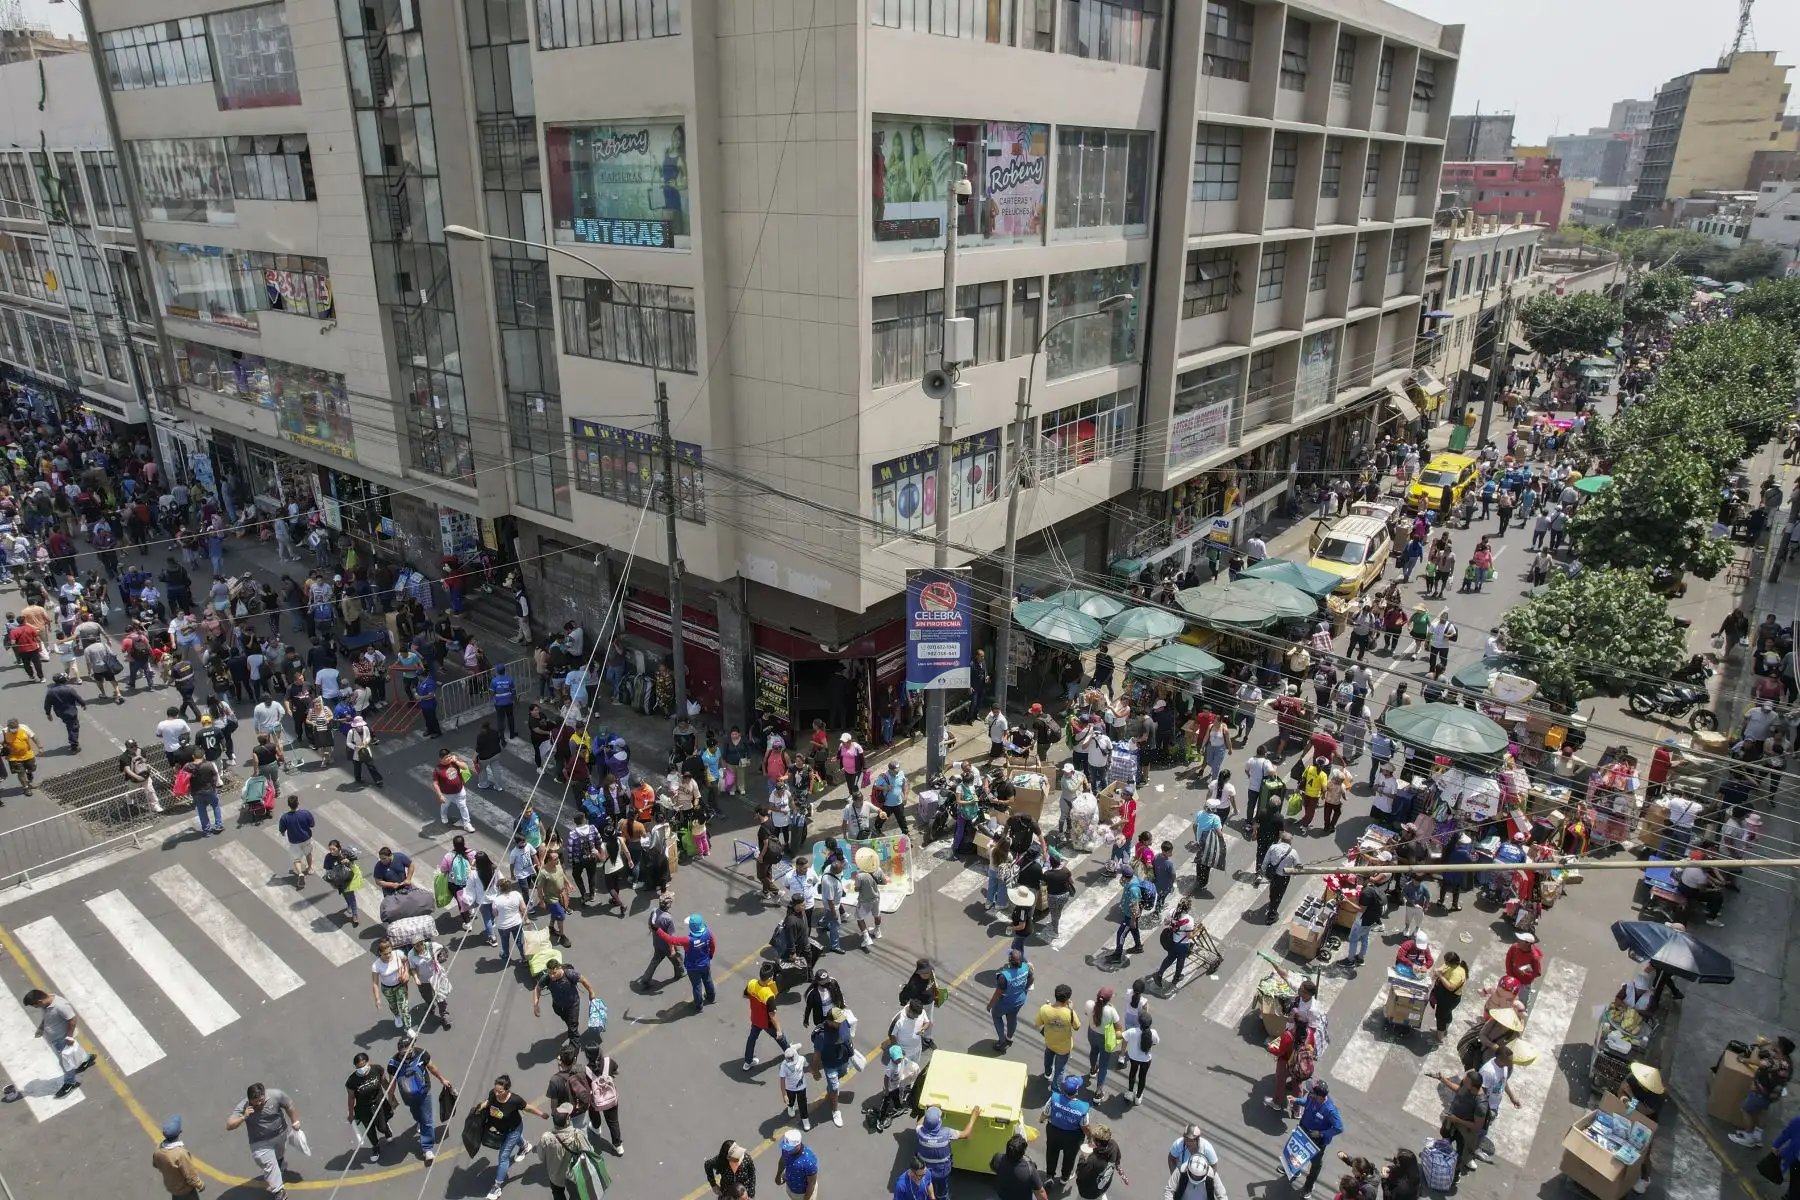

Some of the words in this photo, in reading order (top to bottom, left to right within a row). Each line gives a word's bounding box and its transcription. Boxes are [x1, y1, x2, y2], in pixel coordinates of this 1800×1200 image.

[592, 129, 649, 160] Robeny
[990, 157, 1044, 194] Robeny
[880, 436, 986, 481] MULTMAX
[914, 611, 963, 620] CELEBRA
[206, 736, 216, 750] 10
